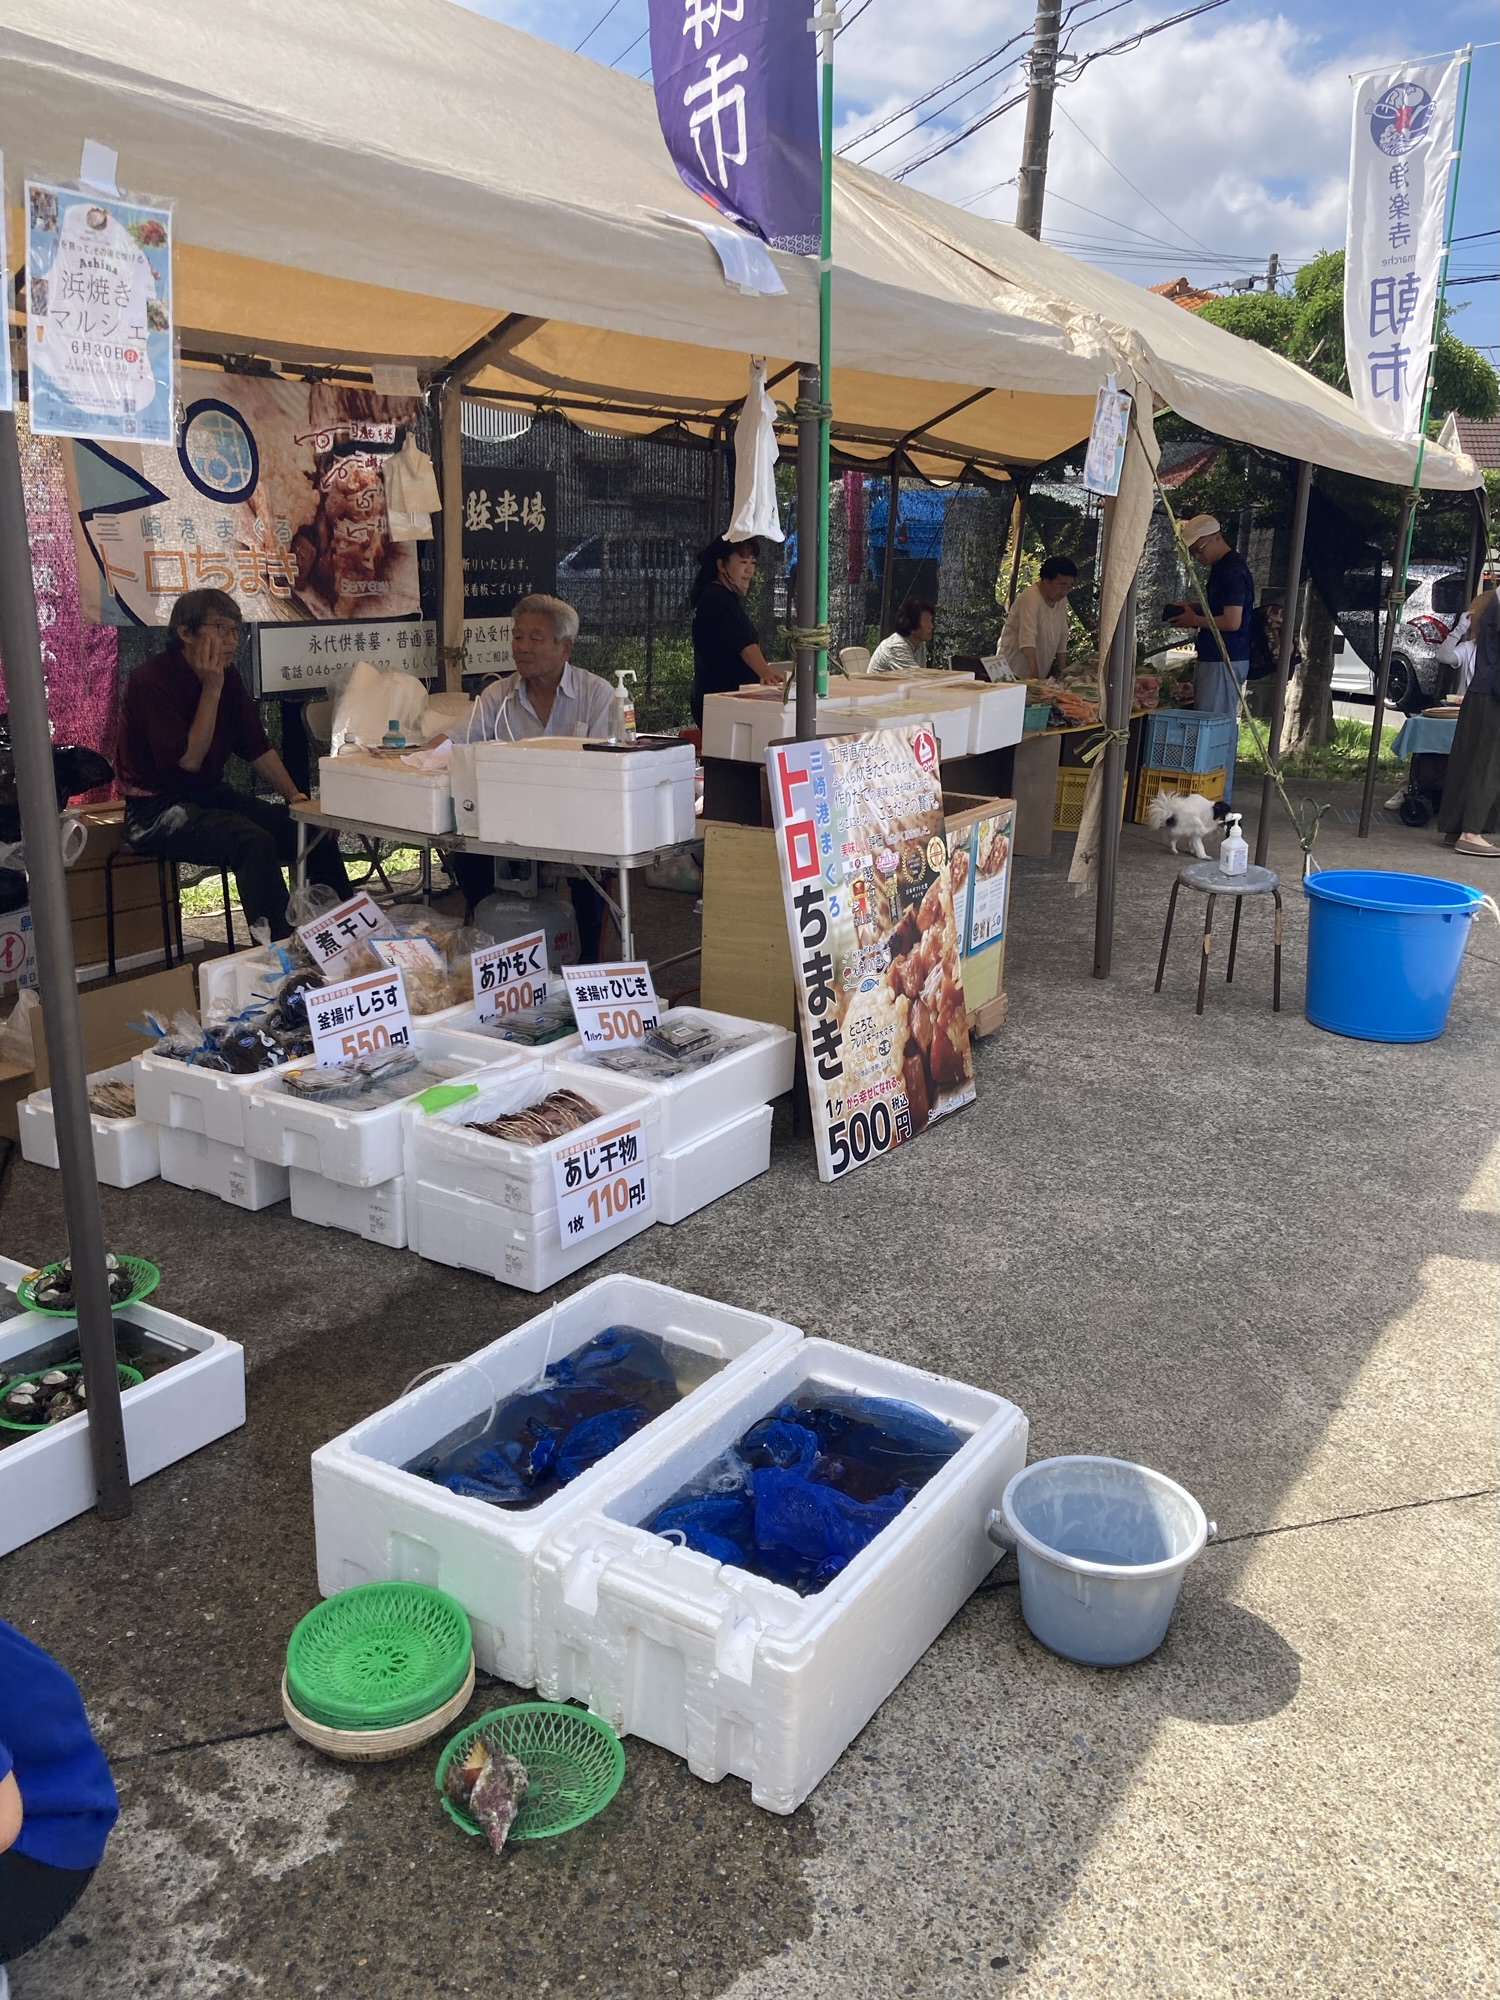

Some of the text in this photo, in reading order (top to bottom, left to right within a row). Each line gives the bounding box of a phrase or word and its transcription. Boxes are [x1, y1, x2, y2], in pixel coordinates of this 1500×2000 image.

[61, 270, 131, 308] 浜焼き
[50, 309, 146, 341] マルシェ
[71, 340, 124, 361] 6月30日
[98, 541, 301, 600] トロちまき
[464, 625, 510, 644] 申込受付
[280, 665, 303, 681] 電話
[810, 751, 841, 918] 三崎港まぐろ
[315, 911, 378, 957] 煮干し
[777, 751, 844, 1081] トロちまき
[479, 944, 541, 990] あかもく
[317, 985, 399, 1031] 釜揚げしらす
[575, 976, 649, 1002] 釜揚げひじき
[892, 1094, 908, 1111] 税込
[564, 1134, 637, 1188] あじ干物
[568, 1214, 584, 1234] 1枚
